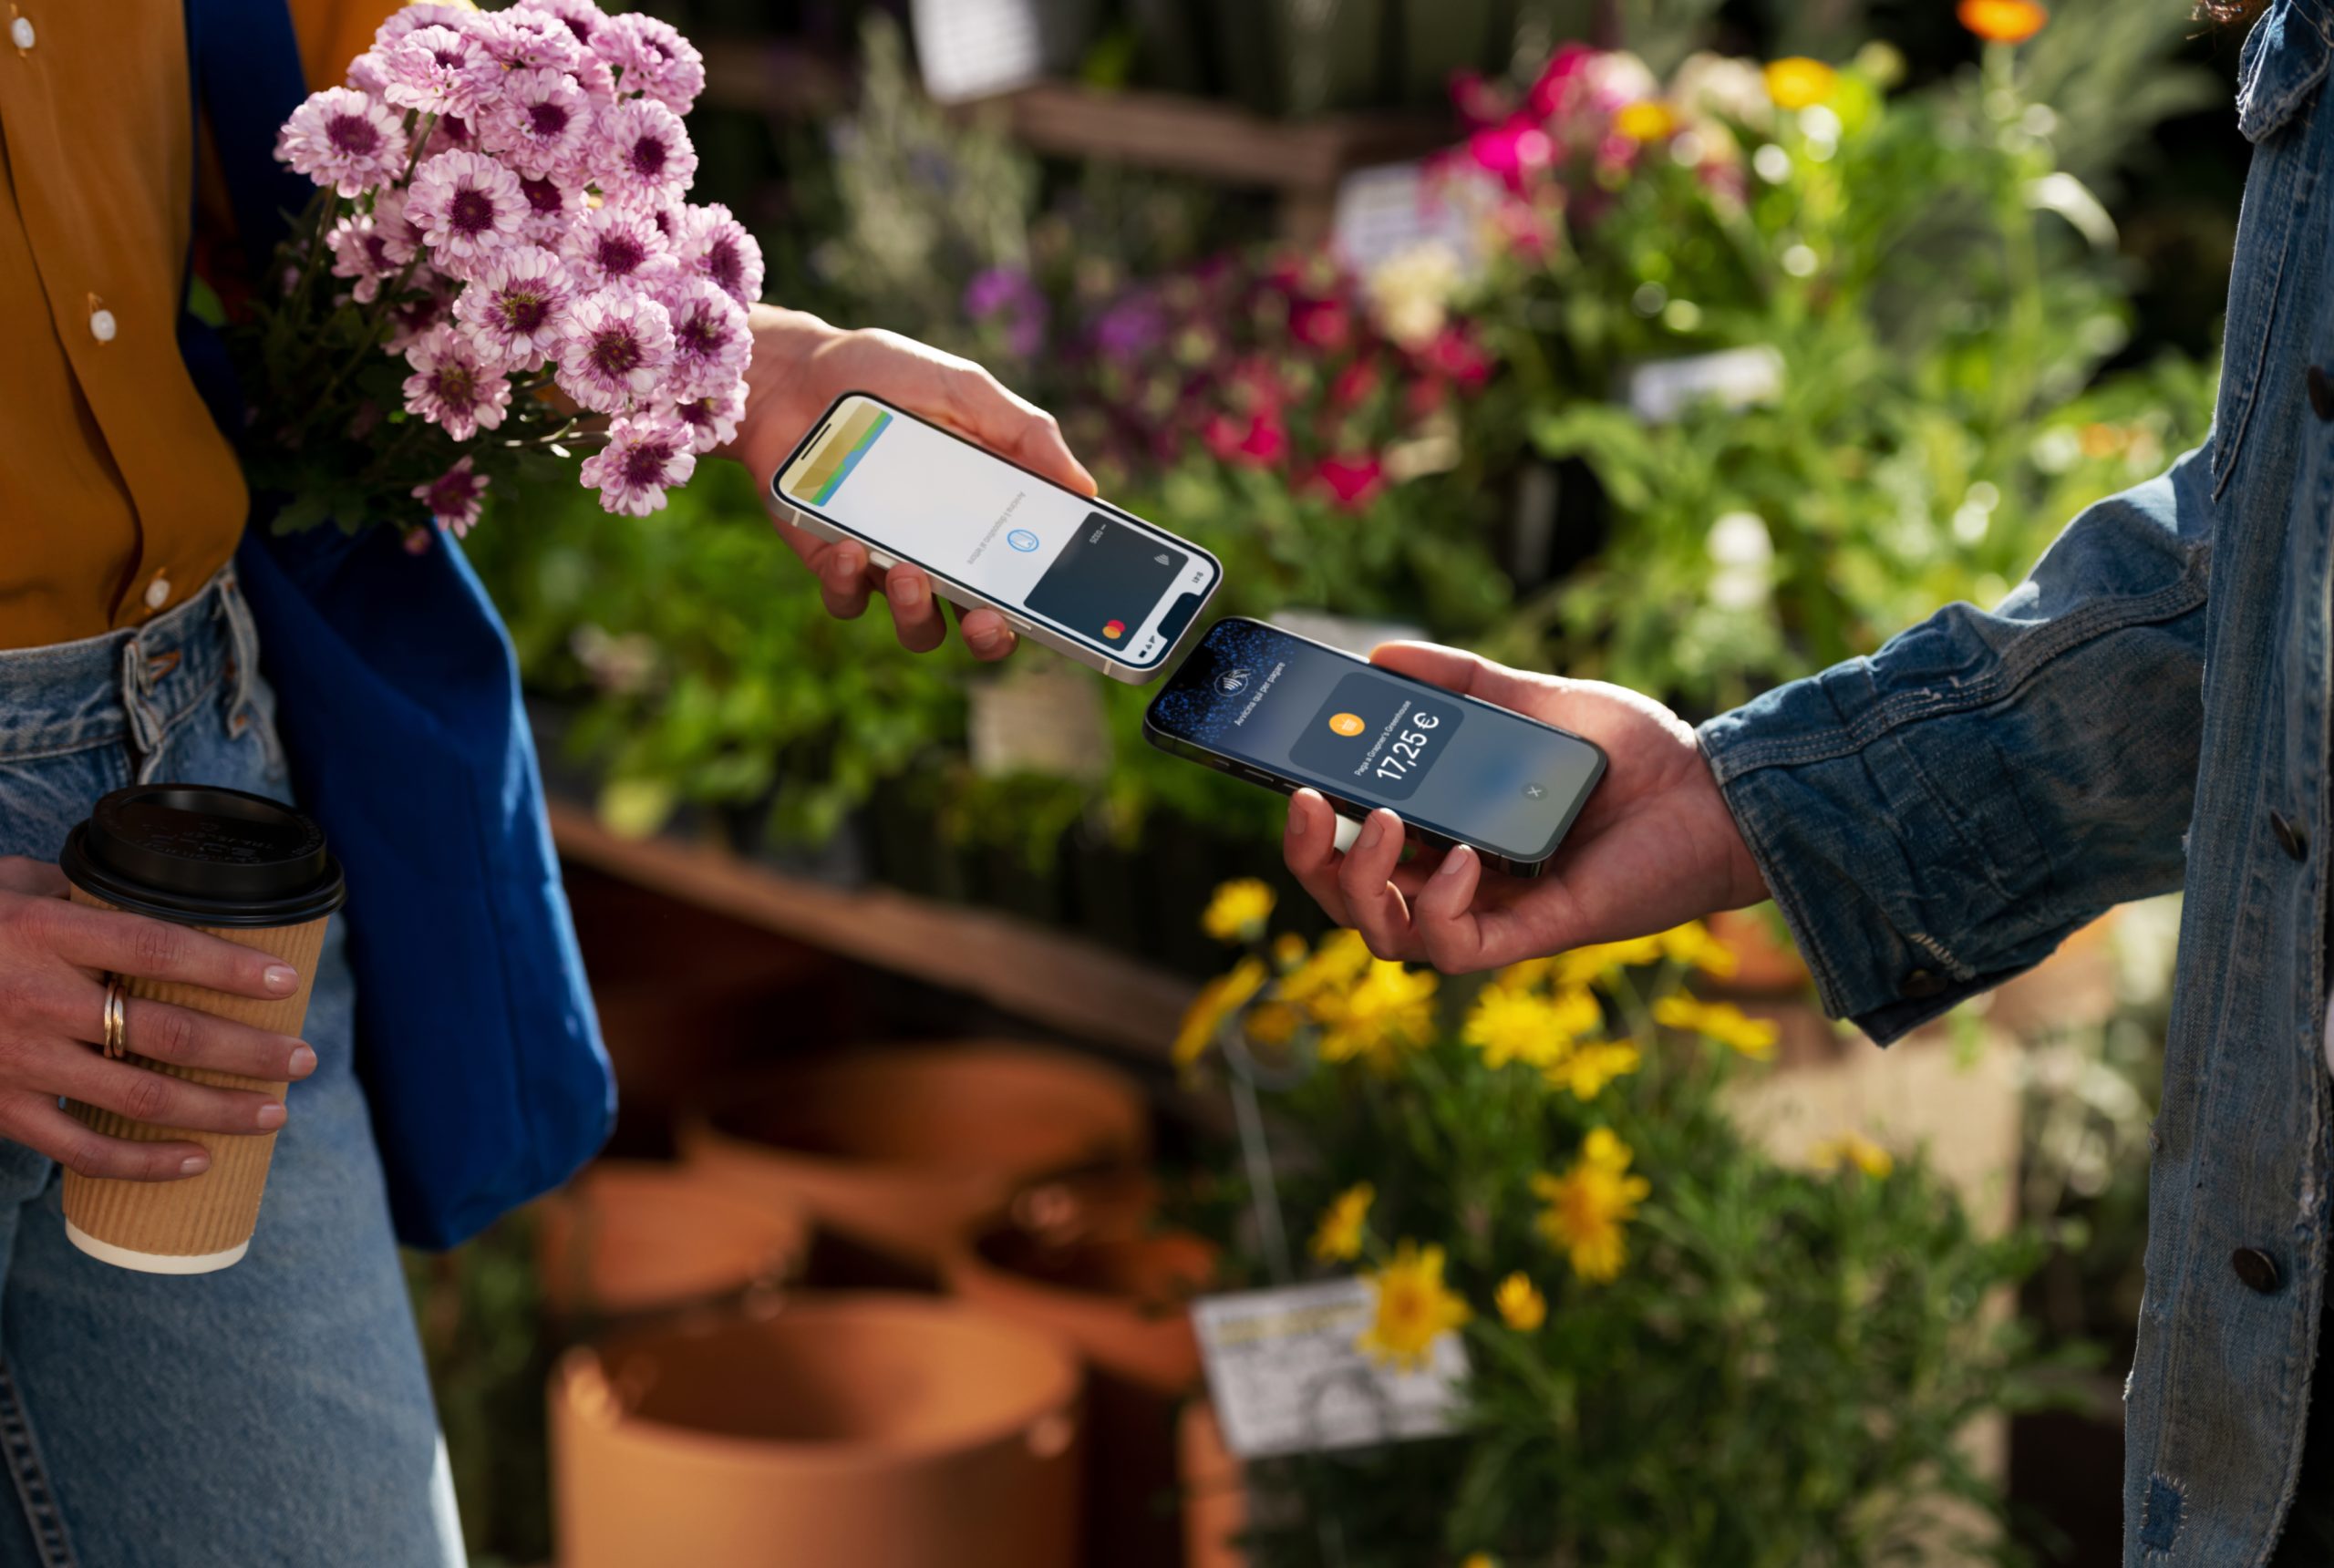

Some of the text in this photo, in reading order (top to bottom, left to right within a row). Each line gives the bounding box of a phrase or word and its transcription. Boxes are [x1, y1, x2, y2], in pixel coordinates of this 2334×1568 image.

[1234, 662, 1286, 727] Avvicina qui per pagare
[1354, 761, 1368, 776] Paga
[1385, 700, 1411, 732] Greenhouse
[1377, 712, 1440, 779] 17,25 €
